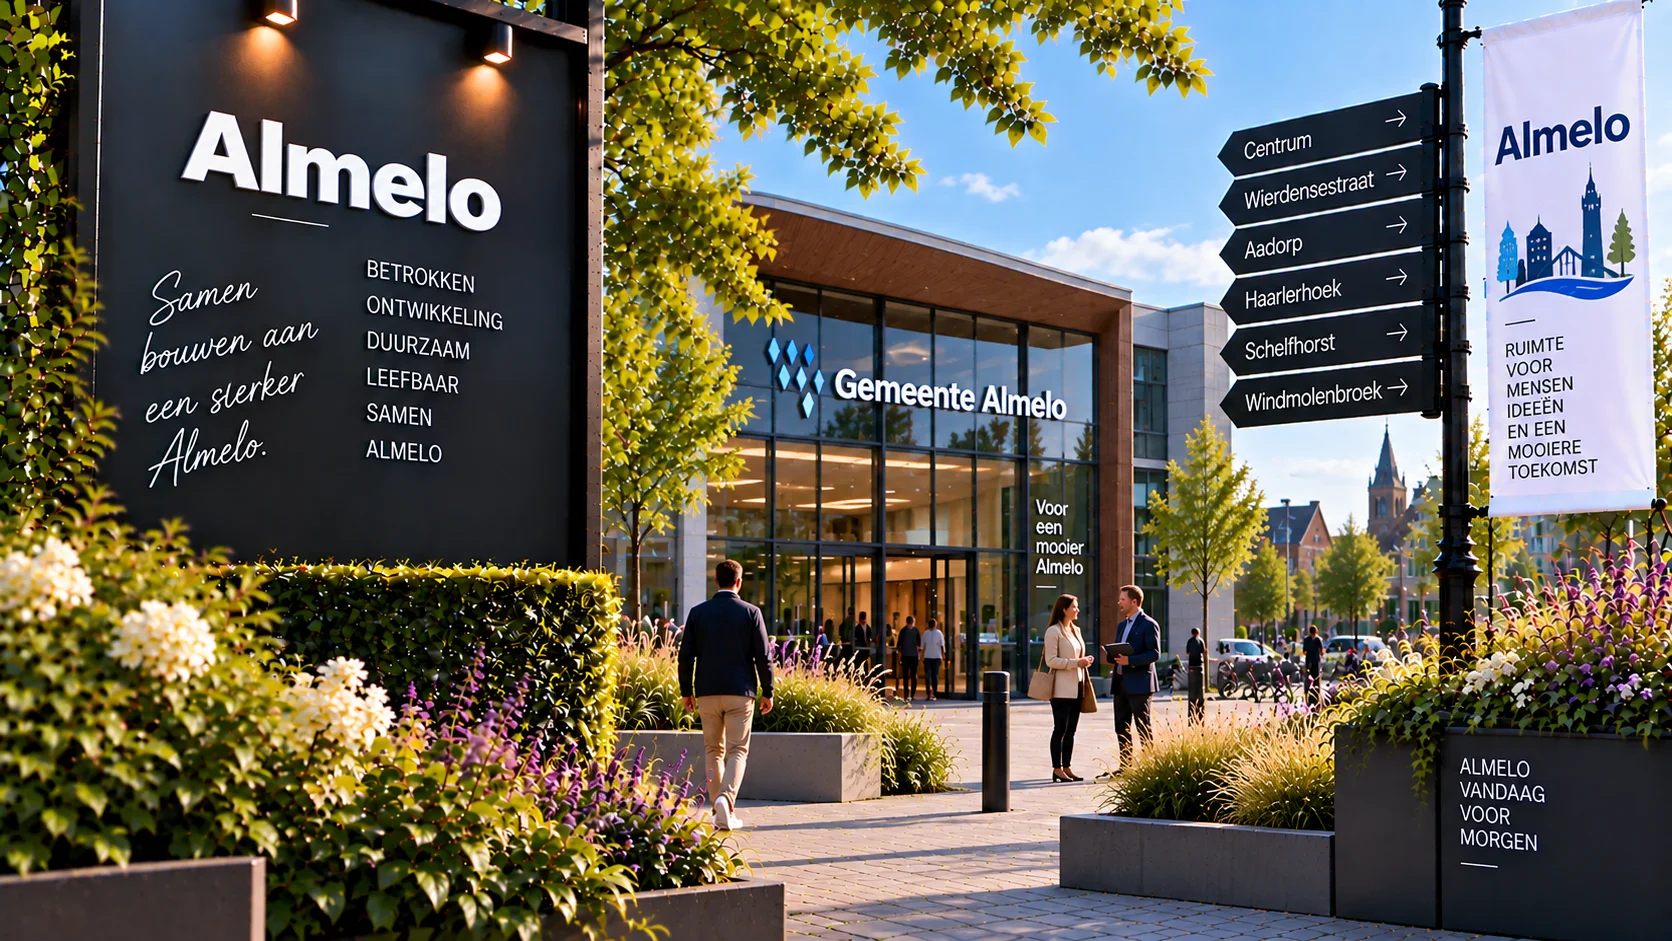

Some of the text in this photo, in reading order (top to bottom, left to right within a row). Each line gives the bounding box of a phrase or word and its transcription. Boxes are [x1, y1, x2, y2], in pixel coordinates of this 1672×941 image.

[1245, 135, 1311, 159] Centrum
[1494, 105, 1631, 166] Almelo
[181, 109, 502, 232] Almelo
[1244, 170, 1375, 210] Wierdensestraat
[1245, 237, 1302, 259] Aadorp
[368, 260, 474, 293] BETROKKEN
[150, 270, 258, 325] Samen
[1244, 279, 1342, 309] Haarlerhoek
[366, 295, 503, 331] ONTWIKKELING
[140, 322, 319, 374] bouwen aan
[368, 331, 469, 359] DUURZAAM
[1246, 334, 1335, 360] Schelfhorst
[1505, 336, 1565, 358] RUIMTE
[1506, 358, 1553, 378] VOOR
[368, 367, 458, 394] LEEFBAAR
[1507, 376, 1574, 398] MENSEN
[836, 369, 1067, 419] Gemeente Almelo
[1244, 380, 1383, 412] Windmolenbroek
[146, 397, 198, 423] een
[367, 403, 431, 426] SAMEN
[1507, 396, 1564, 419] IDEEËN
[1508, 420, 1565, 439] EN EEN
[147, 419, 267, 488] Almelo.
[366, 440, 442, 462] ALMELO
[1508, 439, 1582, 460] MOOIERE
[1508, 458, 1599, 480] TOEKOMST
[1036, 499, 1068, 516] Voor
[1036, 522, 1062, 535] een
[1037, 539, 1084, 555] mooier
[1036, 558, 1083, 575] Almelo
[1460, 758, 1529, 777] ALMELO
[1459, 781, 1546, 803] VANDAAG
[1460, 804, 1510, 825] VOOR
[1461, 828, 1537, 851] MORGEN
